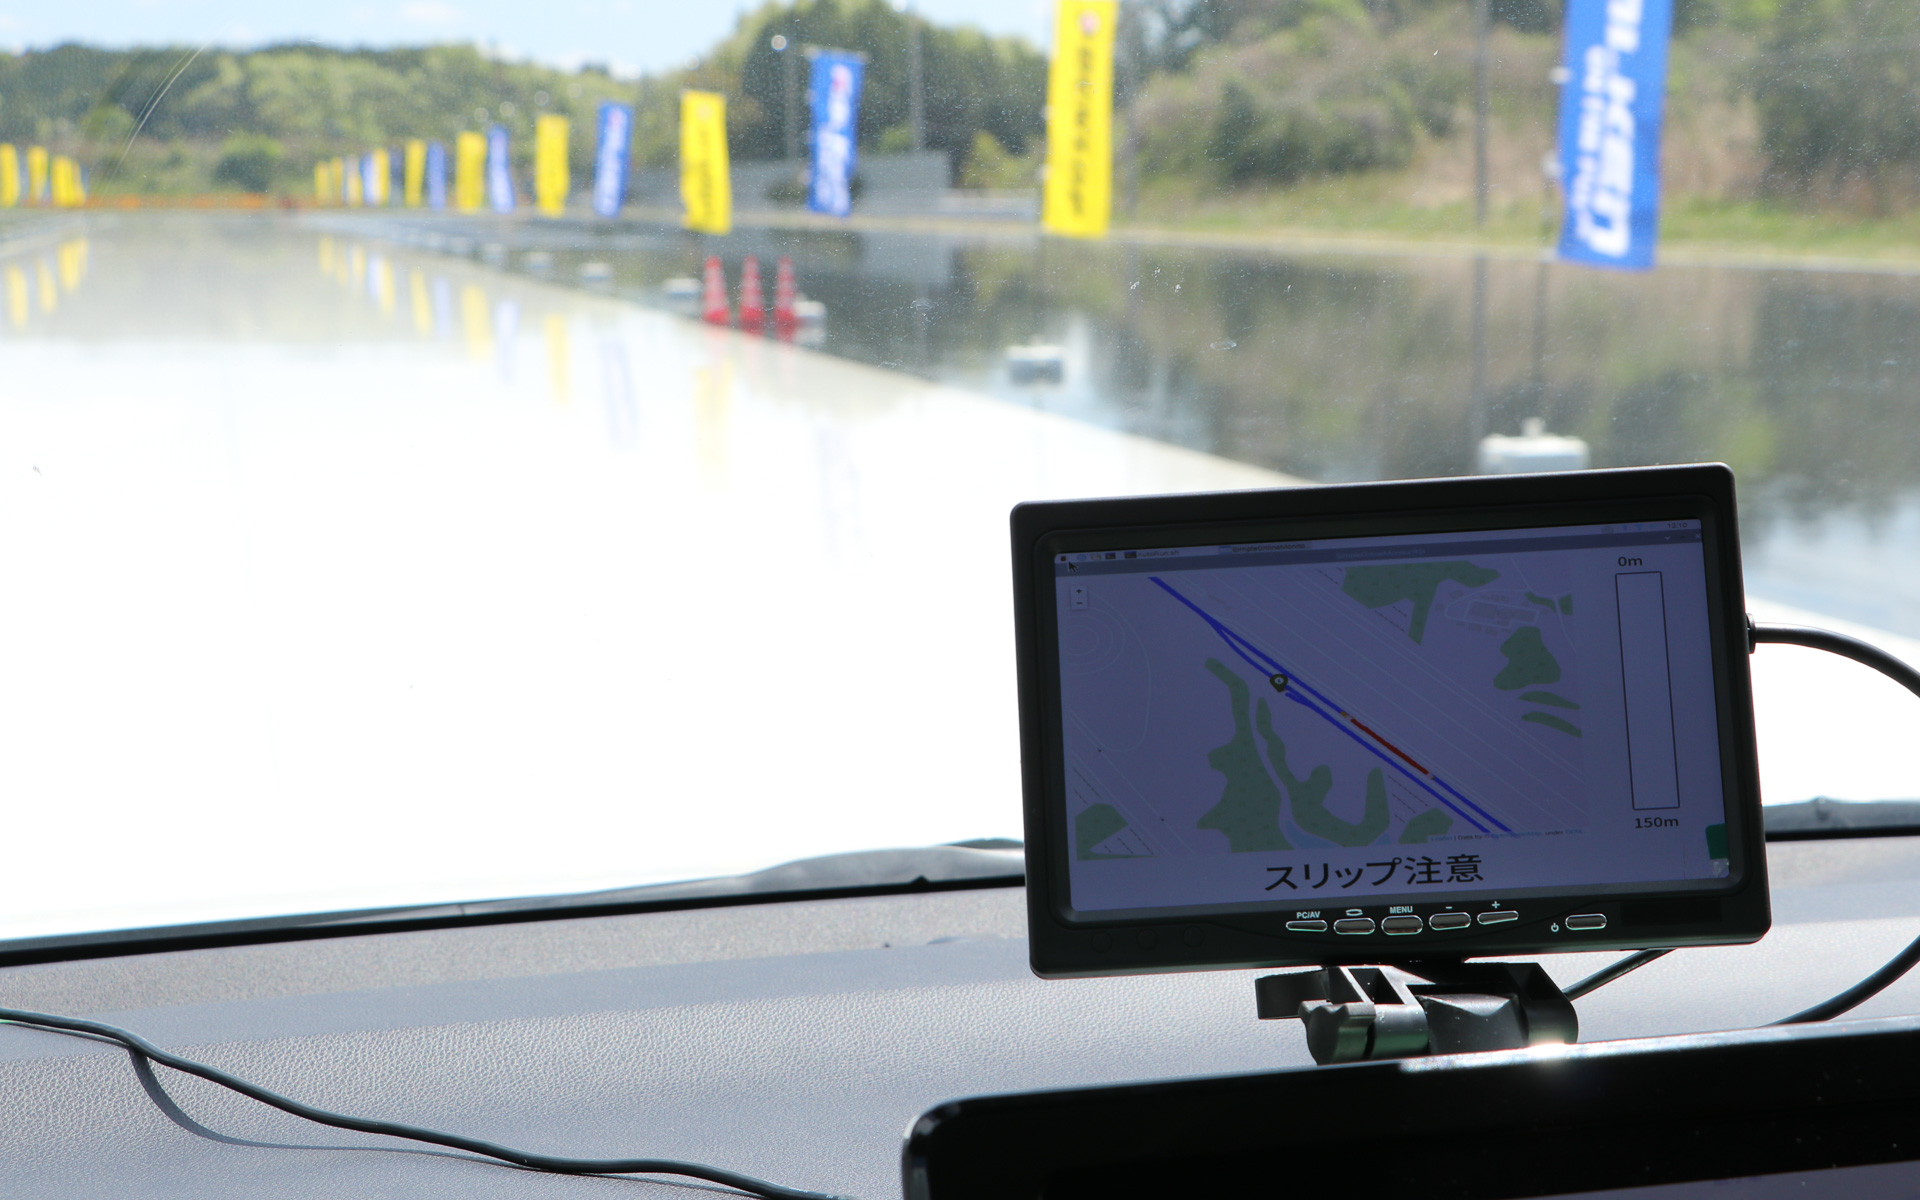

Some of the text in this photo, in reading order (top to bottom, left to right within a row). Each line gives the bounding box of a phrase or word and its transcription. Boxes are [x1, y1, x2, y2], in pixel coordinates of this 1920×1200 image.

[1617, 556, 1643, 567] 0m
[1634, 817, 1679, 829] 150m
[1264, 853, 1484, 891] スリップ注意
[1296, 910, 1321, 919] PC/AV
[1389, 905, 1413, 914] MENU
